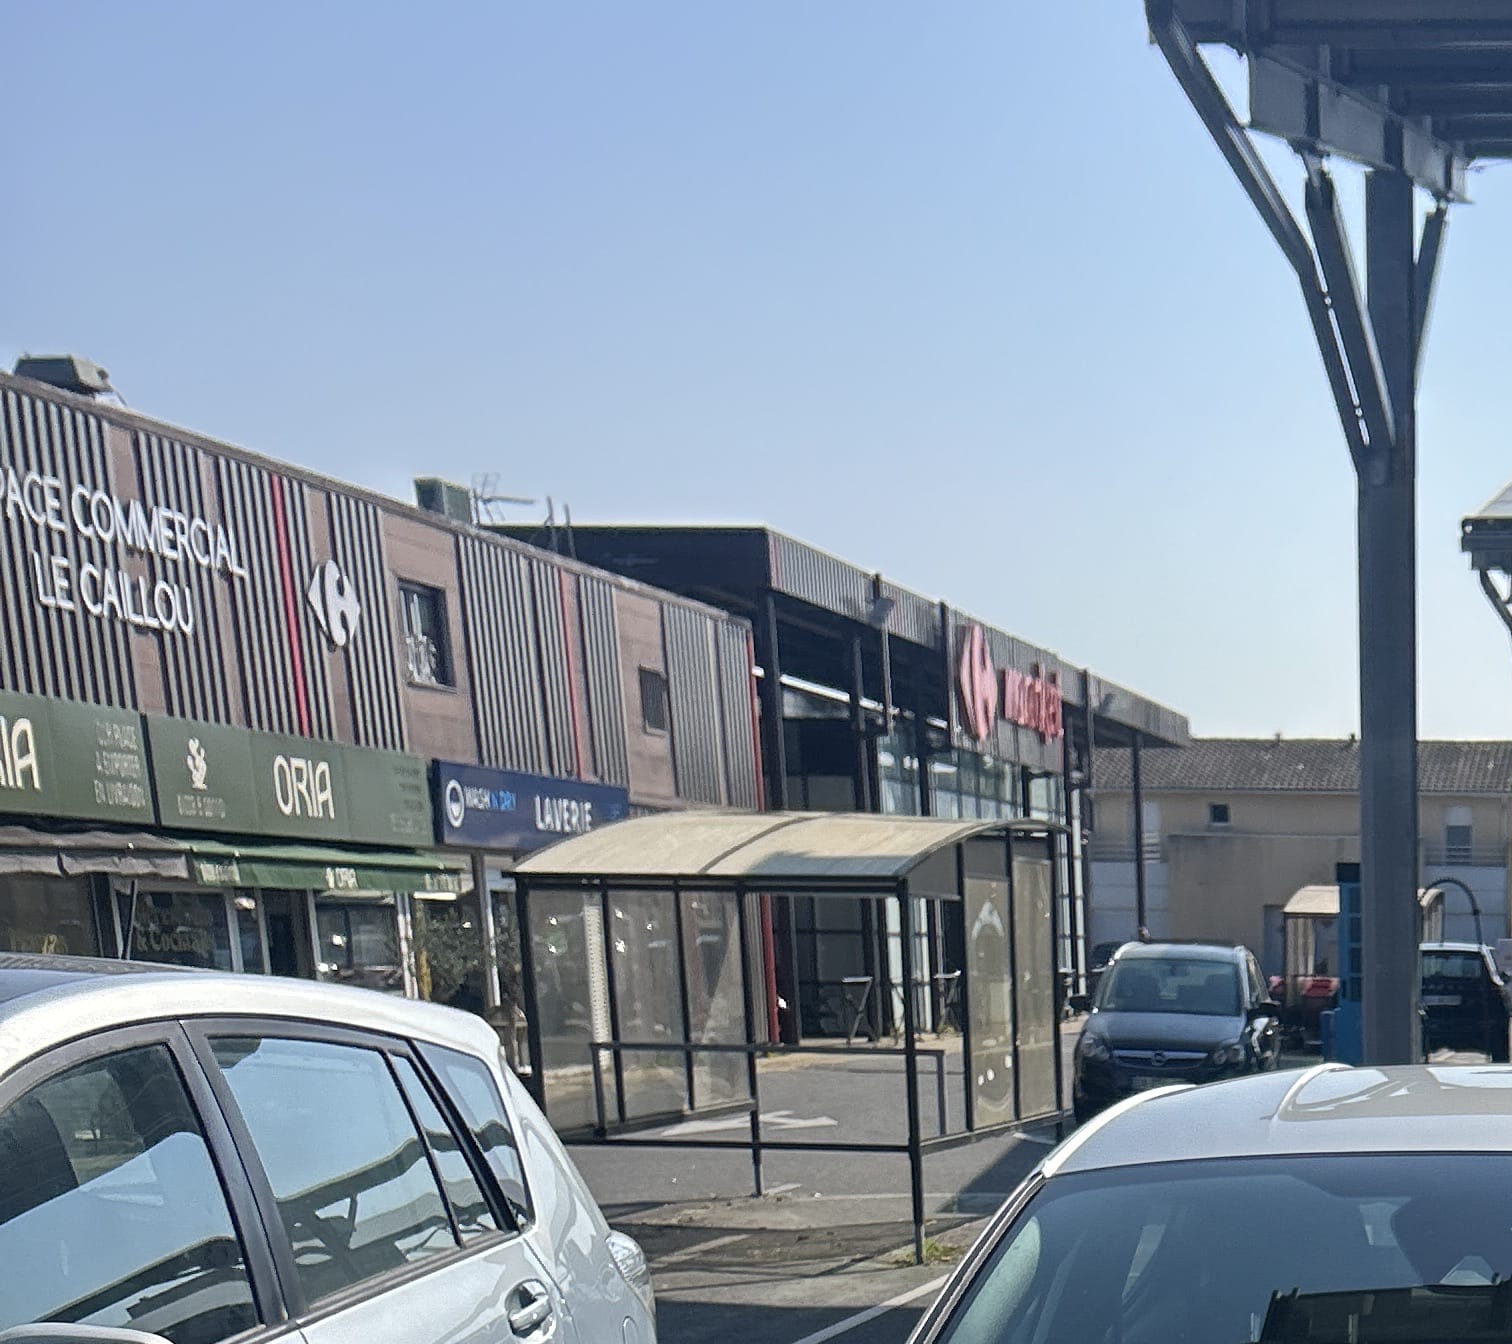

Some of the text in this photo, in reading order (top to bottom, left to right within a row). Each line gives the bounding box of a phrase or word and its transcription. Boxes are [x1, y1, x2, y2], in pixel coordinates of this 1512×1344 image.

[0, 465, 249, 579] ACE COMMERCIAL
[33, 551, 193, 635] LE CAILLOU
[273, 754, 335, 819] ORIA
[535, 794, 592, 833] LAVERIE
